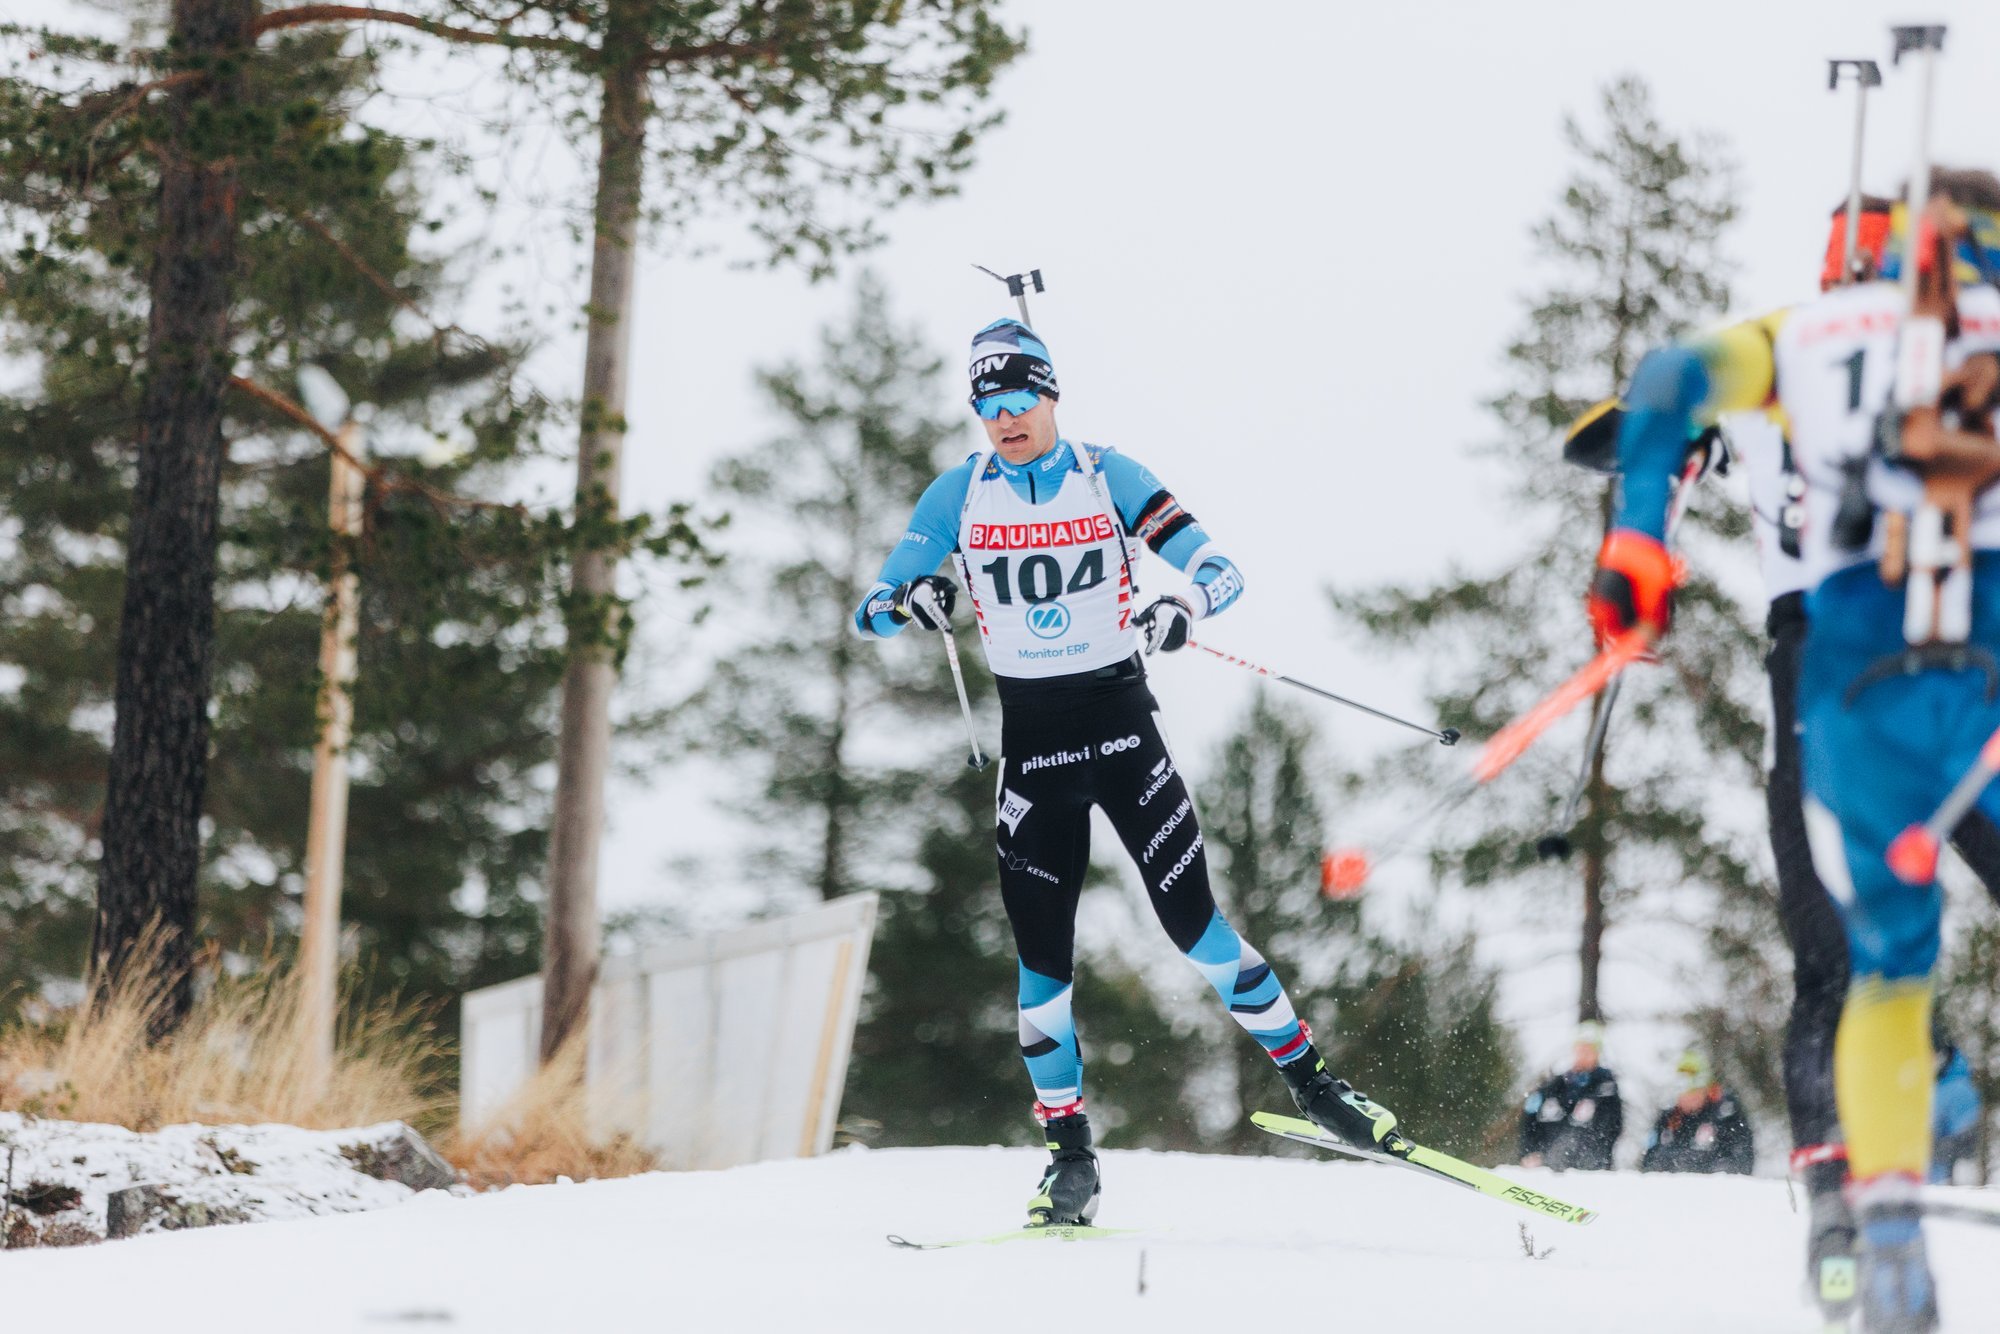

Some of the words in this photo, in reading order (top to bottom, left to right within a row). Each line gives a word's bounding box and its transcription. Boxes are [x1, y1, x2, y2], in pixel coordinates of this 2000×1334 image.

[970, 515, 1113, 548] BAUHAUS
[982, 548, 1107, 606] 104
[1018, 648, 1064, 660] Monitor
[1066, 642, 1090, 656] ERP
[1022, 746, 1090, 774] piletilevi
[1003, 800, 1024, 820] iizi
[1026, 865, 1060, 884] KESKUS
[1501, 1186, 1573, 1217] FISCHER
